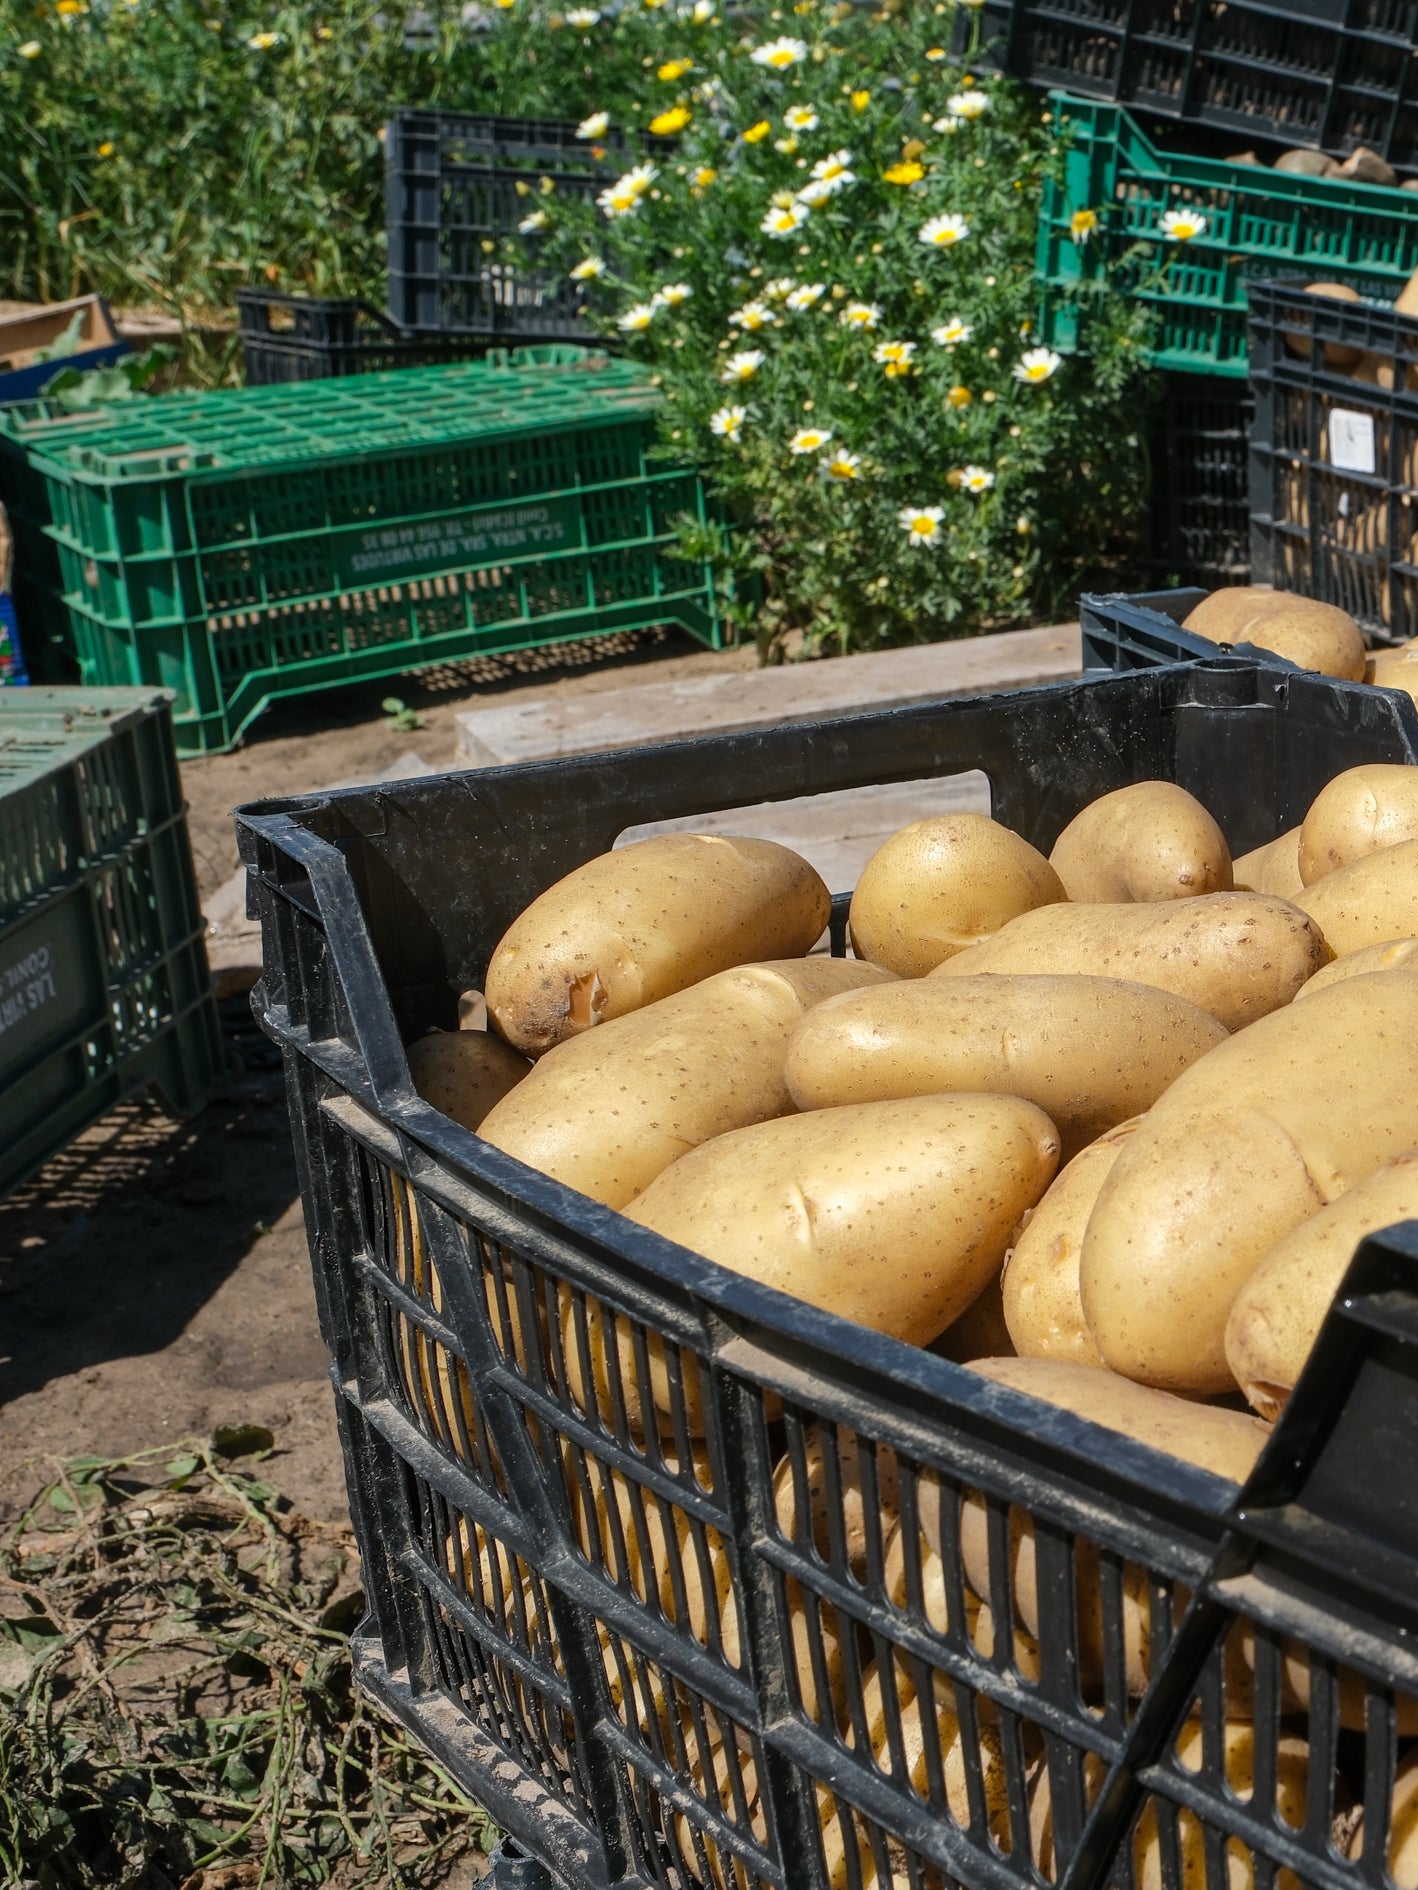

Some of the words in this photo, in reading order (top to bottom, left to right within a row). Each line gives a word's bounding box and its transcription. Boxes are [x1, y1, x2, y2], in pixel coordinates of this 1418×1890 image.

[415, 544, 438, 561] LAS
[439, 540, 458, 556] DE
[351, 547, 414, 572] VIRTUDES
[27, 972, 57, 1010] LAS
